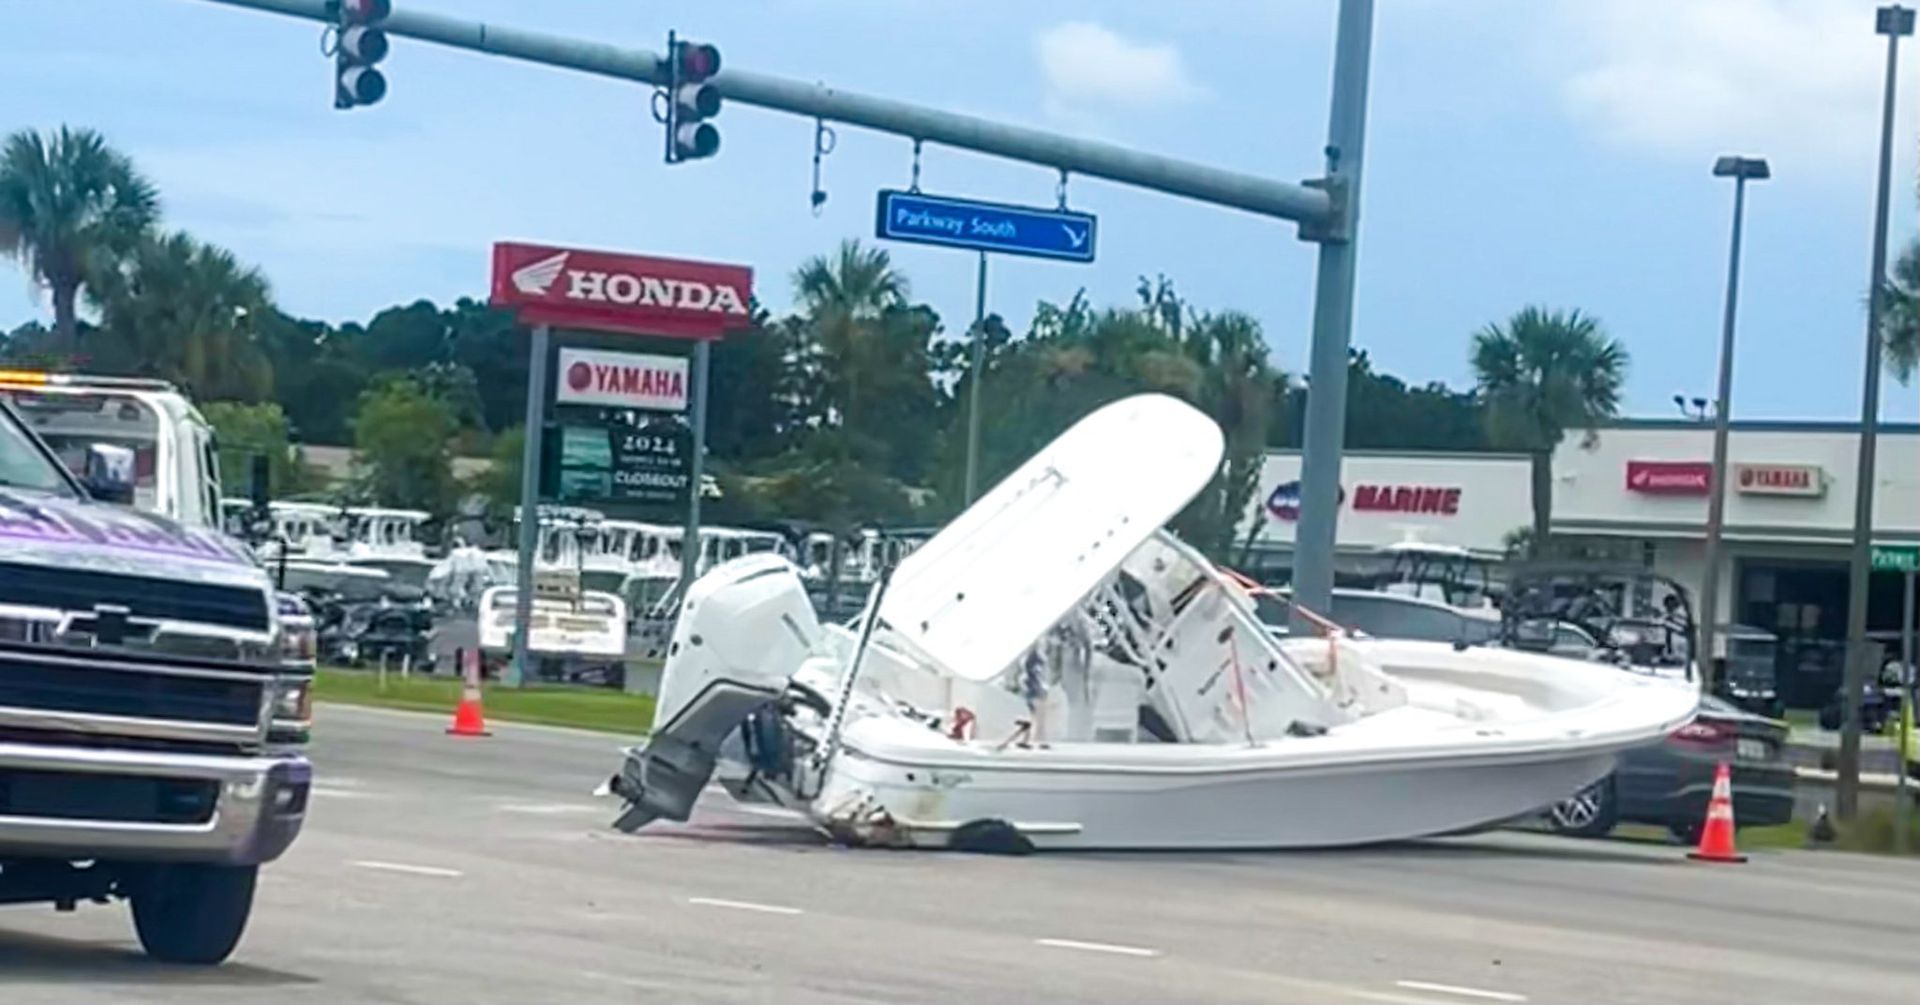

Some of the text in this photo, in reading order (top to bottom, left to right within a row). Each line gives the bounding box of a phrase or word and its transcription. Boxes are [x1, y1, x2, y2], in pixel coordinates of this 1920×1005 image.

[897, 208, 1017, 238] Parkway South
[566, 270, 748, 315] HONDA
[596, 365, 684, 396] YAMAHA
[614, 469, 688, 488] CLOSEOUT
[1757, 470, 1810, 488] YAMAHA
[1353, 485, 1462, 515] MARINE
